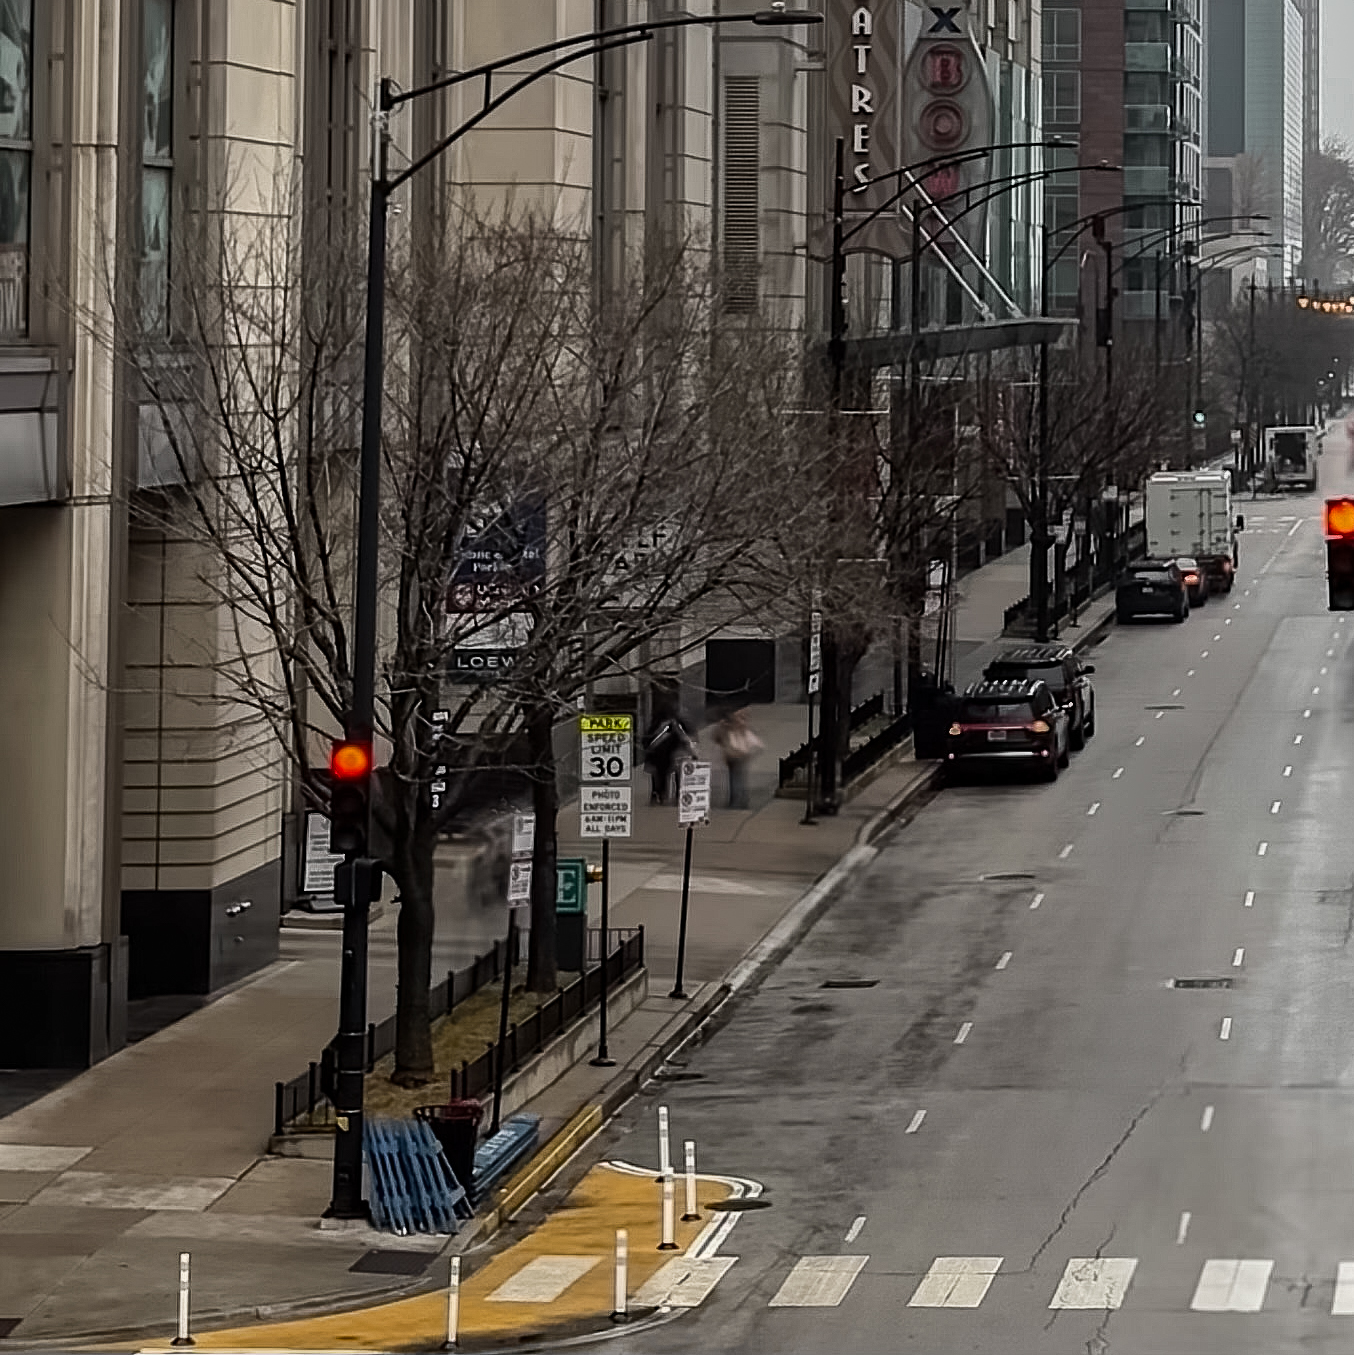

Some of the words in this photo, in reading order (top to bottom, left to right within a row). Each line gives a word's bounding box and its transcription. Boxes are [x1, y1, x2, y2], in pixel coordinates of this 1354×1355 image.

[589, 718, 622, 728] PARK
[587, 733, 626, 743] SPEED
[591, 745, 622, 755] LIMIT
[589, 756, 624, 778] 30
[591, 790, 621, 800] PHOTO
